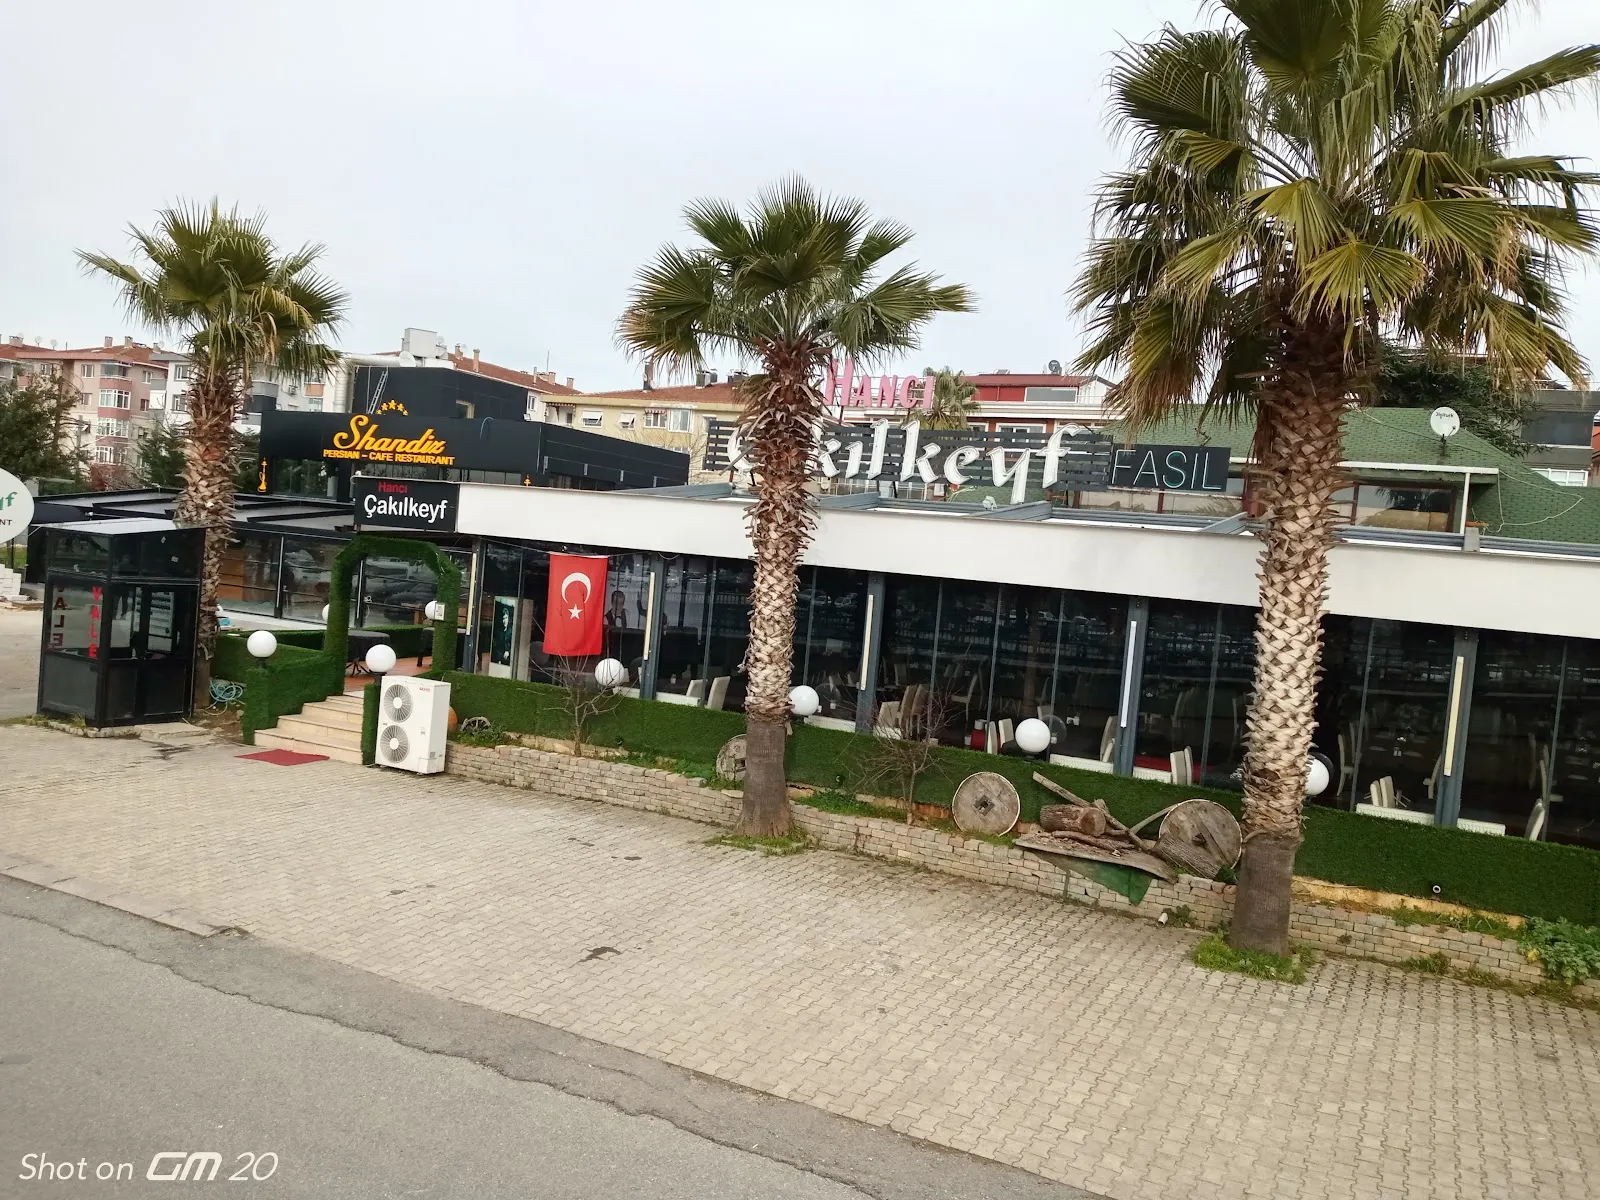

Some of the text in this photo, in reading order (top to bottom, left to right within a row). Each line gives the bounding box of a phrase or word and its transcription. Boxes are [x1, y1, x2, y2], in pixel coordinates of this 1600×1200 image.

[825, 357, 936, 409] HANCI
[333, 414, 447, 455] Shandiz
[323, 449, 360, 460] PERSIAN
[369, 452, 393, 462] CAFE
[395, 453, 456, 466] RESTAURANT
[1111, 449, 1222, 490] FASIL
[378, 481, 408, 494] Hancı
[363, 494, 449, 524] Çakılkeyf
[88, 586, 103, 659] VALE
